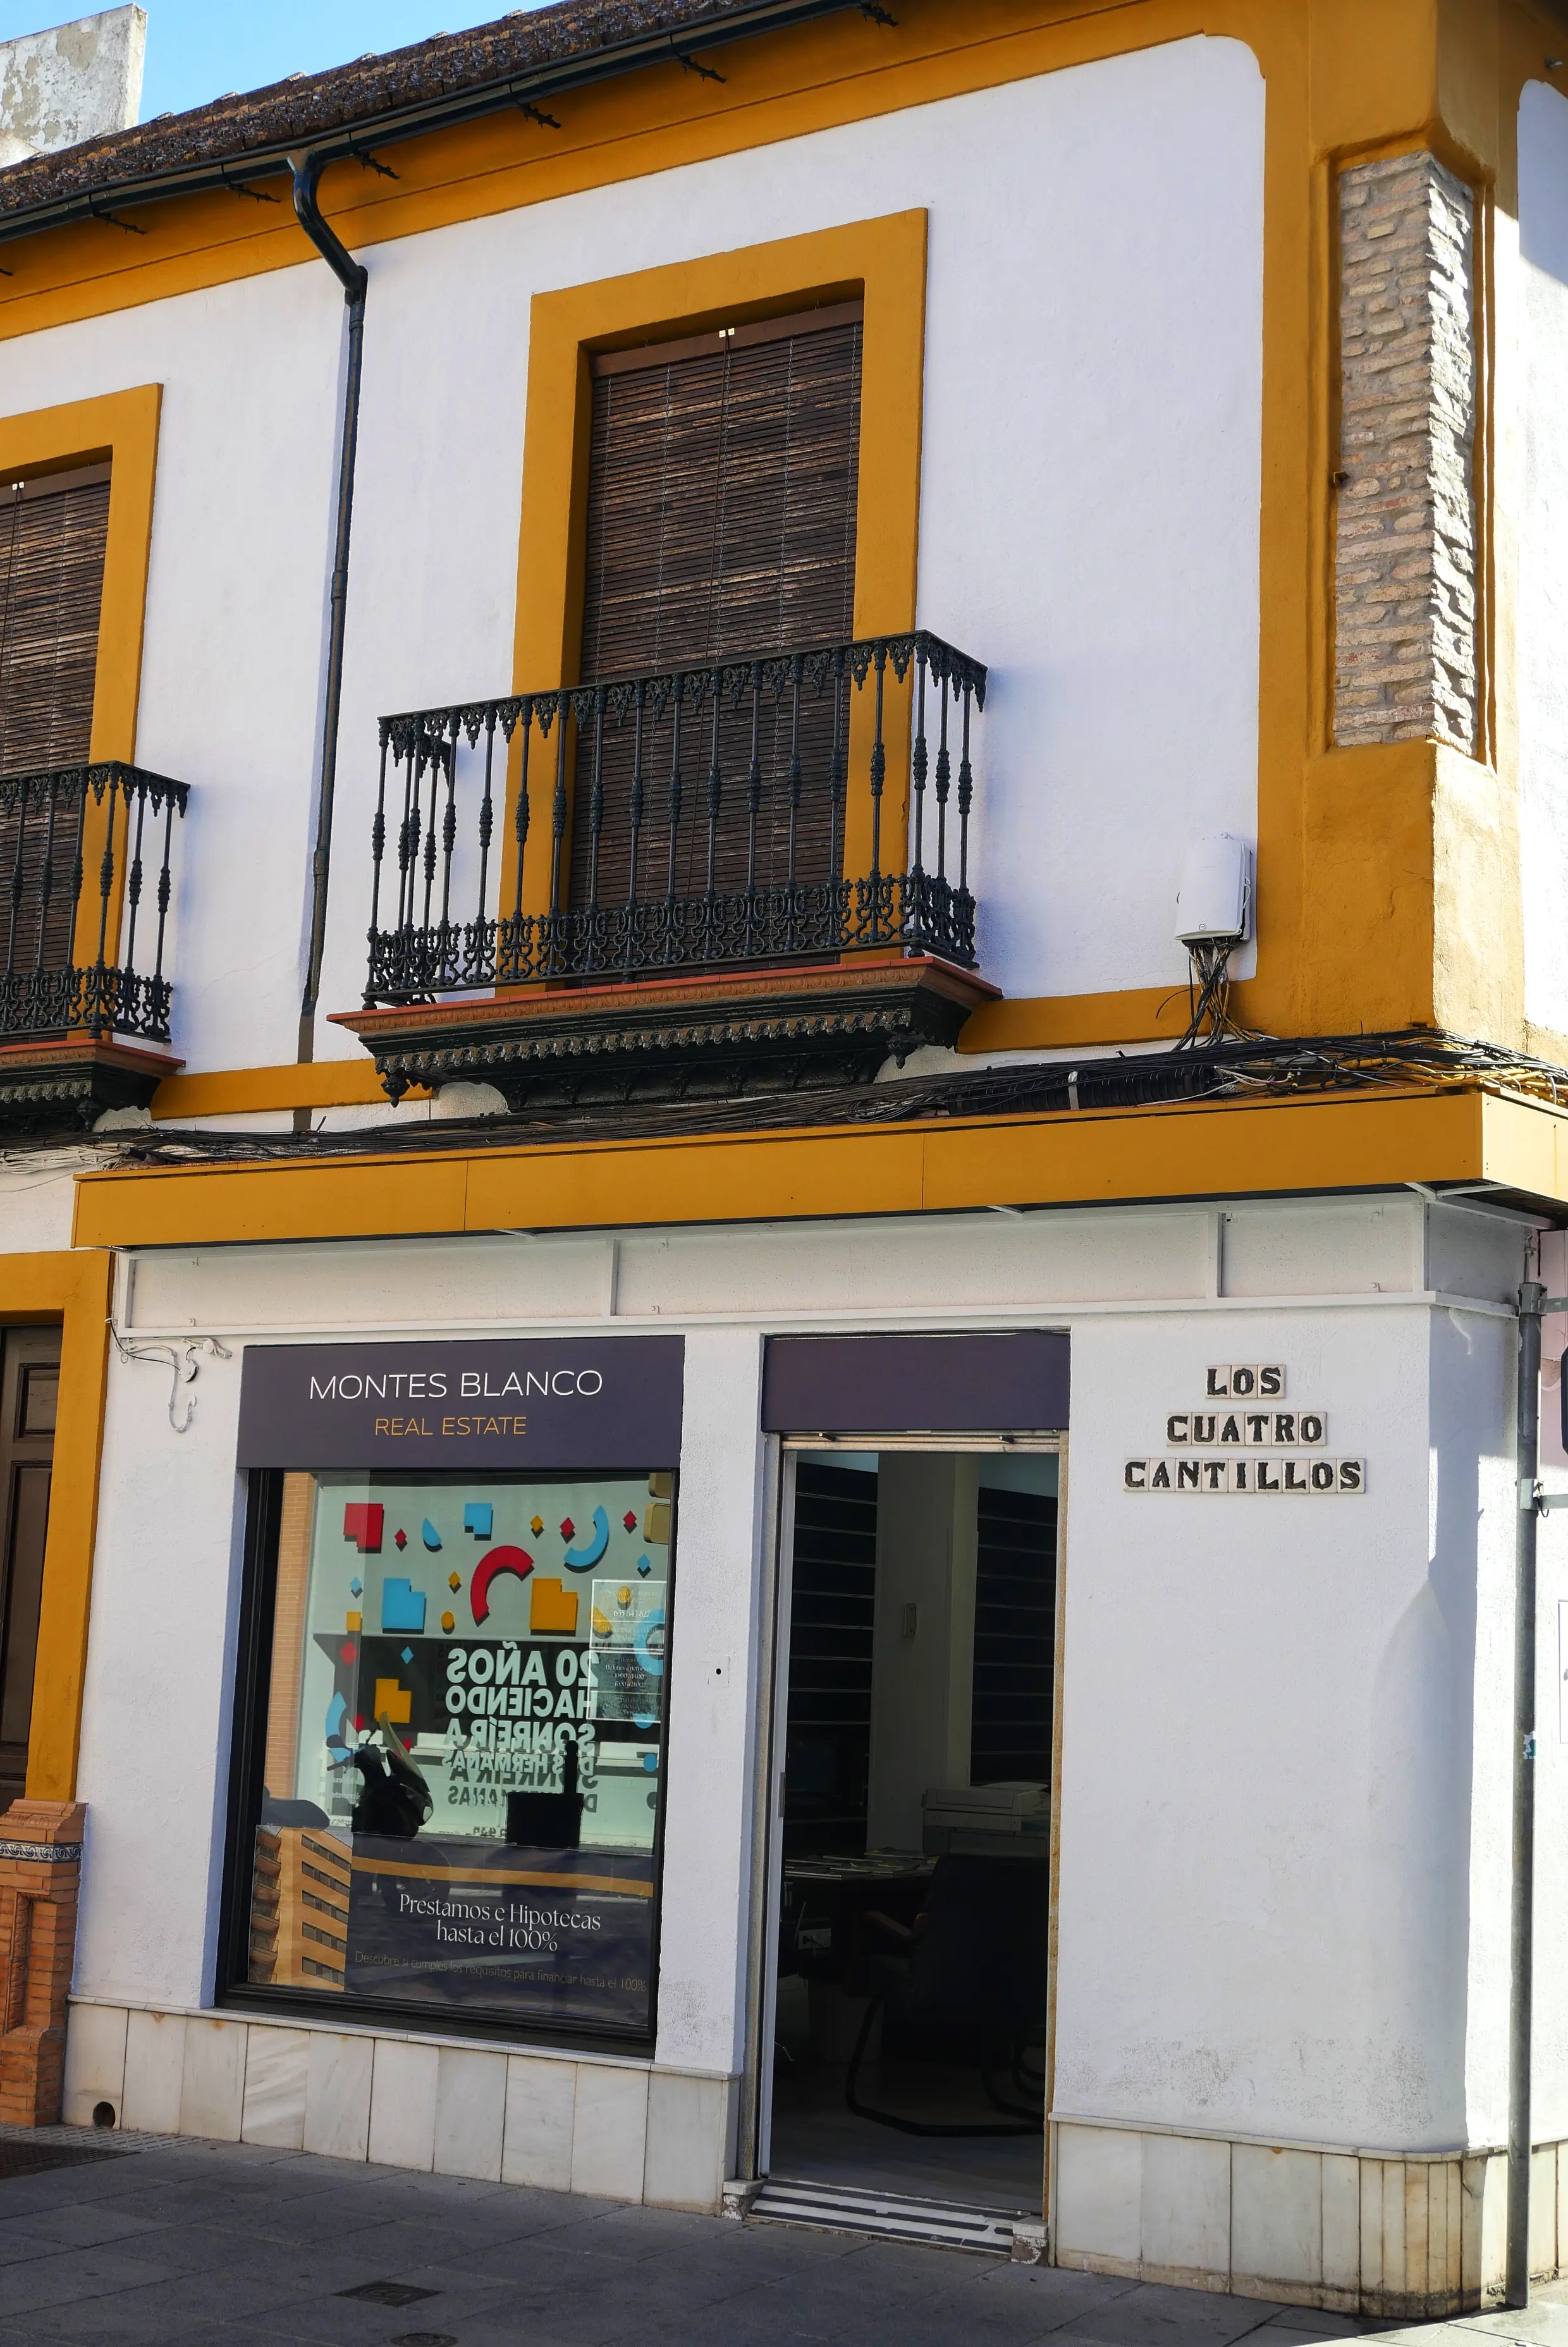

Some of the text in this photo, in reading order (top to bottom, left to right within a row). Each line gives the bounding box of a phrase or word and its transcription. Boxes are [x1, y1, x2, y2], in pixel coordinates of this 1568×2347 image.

[309, 1370, 603, 1400] MONTES BLANCO
[1206, 1367, 1282, 1395] LOS
[374, 1416, 527, 1437] REAL ESTATE
[1167, 1414, 1323, 1443] CUATRO
[1124, 1461, 1361, 1490] CANTILLOS
[626, 1609, 638, 1618] 643
[638, 1610, 651, 1618] 827
[399, 1893, 601, 1930] Prestamos e Hipotecas
[436, 1919, 558, 1952] hasta el 100%
[355, 1951, 647, 1992] Descubre si cumples los requisitos para financiar hasta el 100%
